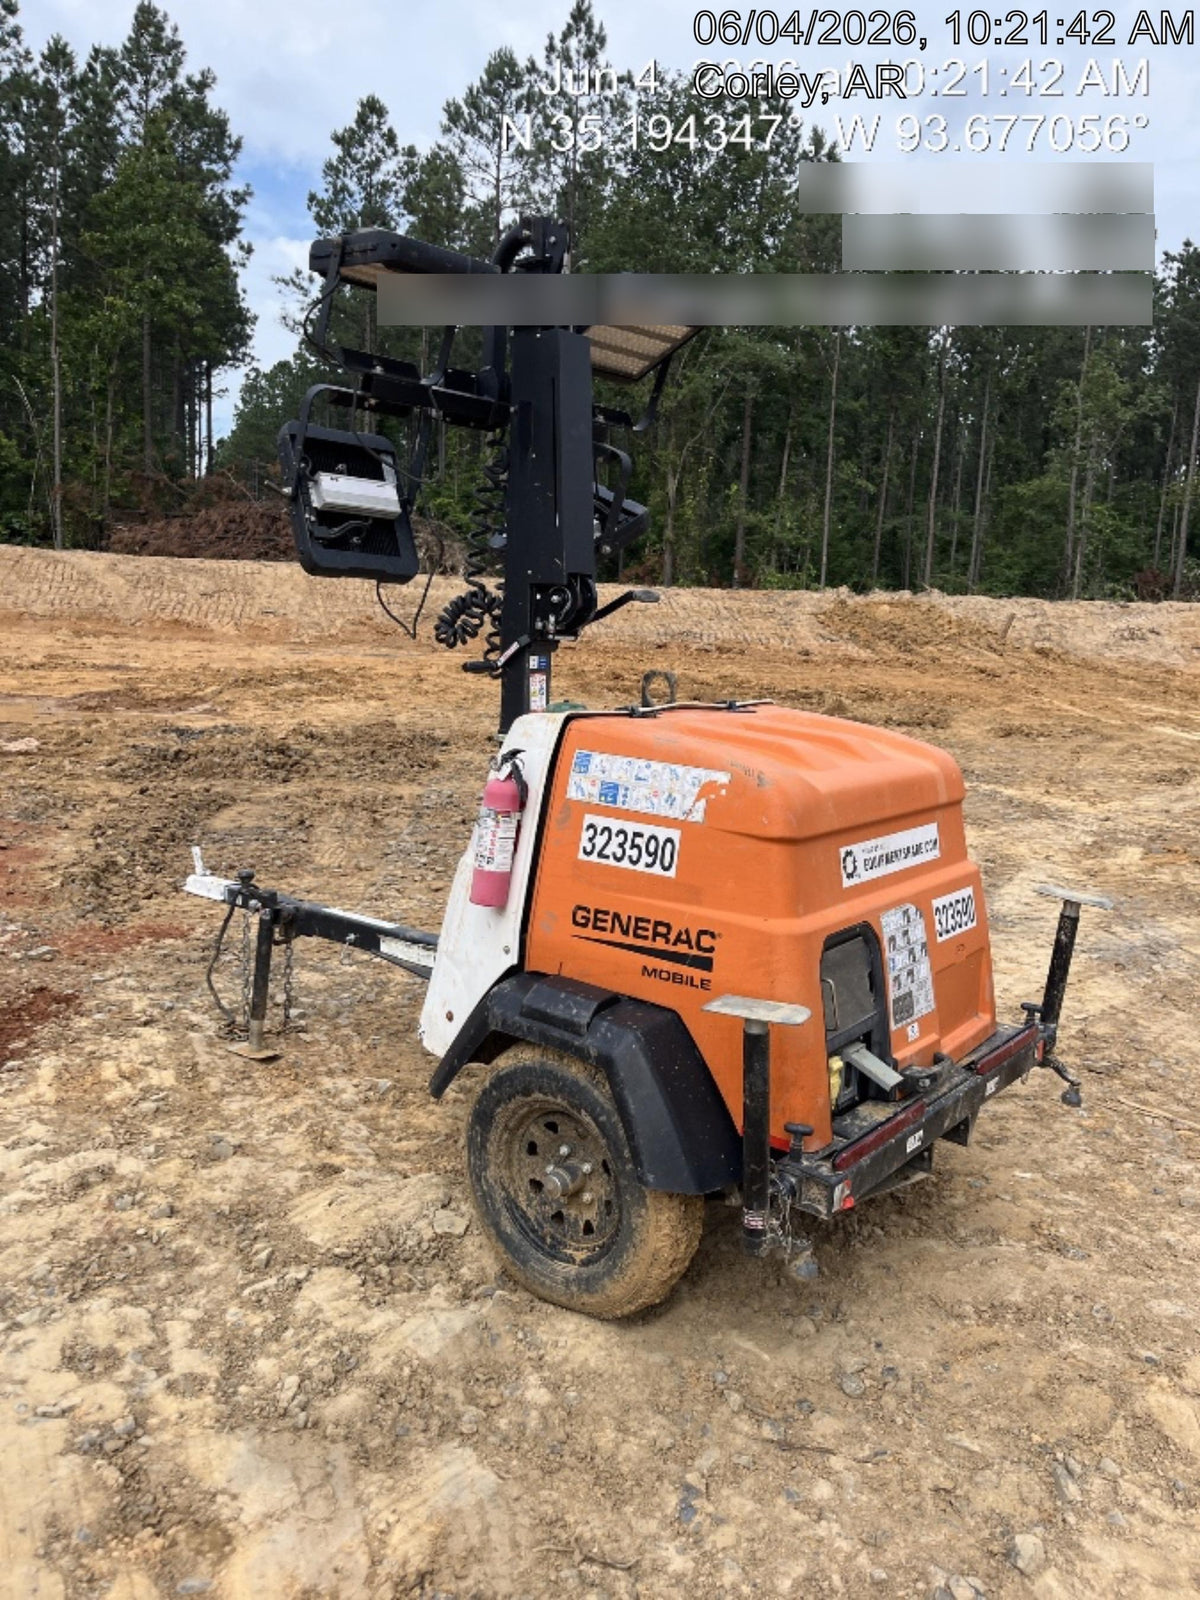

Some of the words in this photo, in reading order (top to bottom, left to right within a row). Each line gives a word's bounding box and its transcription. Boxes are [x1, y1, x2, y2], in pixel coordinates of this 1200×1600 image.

[582, 822, 677, 872] 323590
[571, 904, 717, 954] GENERAC
[934, 893, 976, 938] 323590
[641, 965, 712, 991] MOBILE
